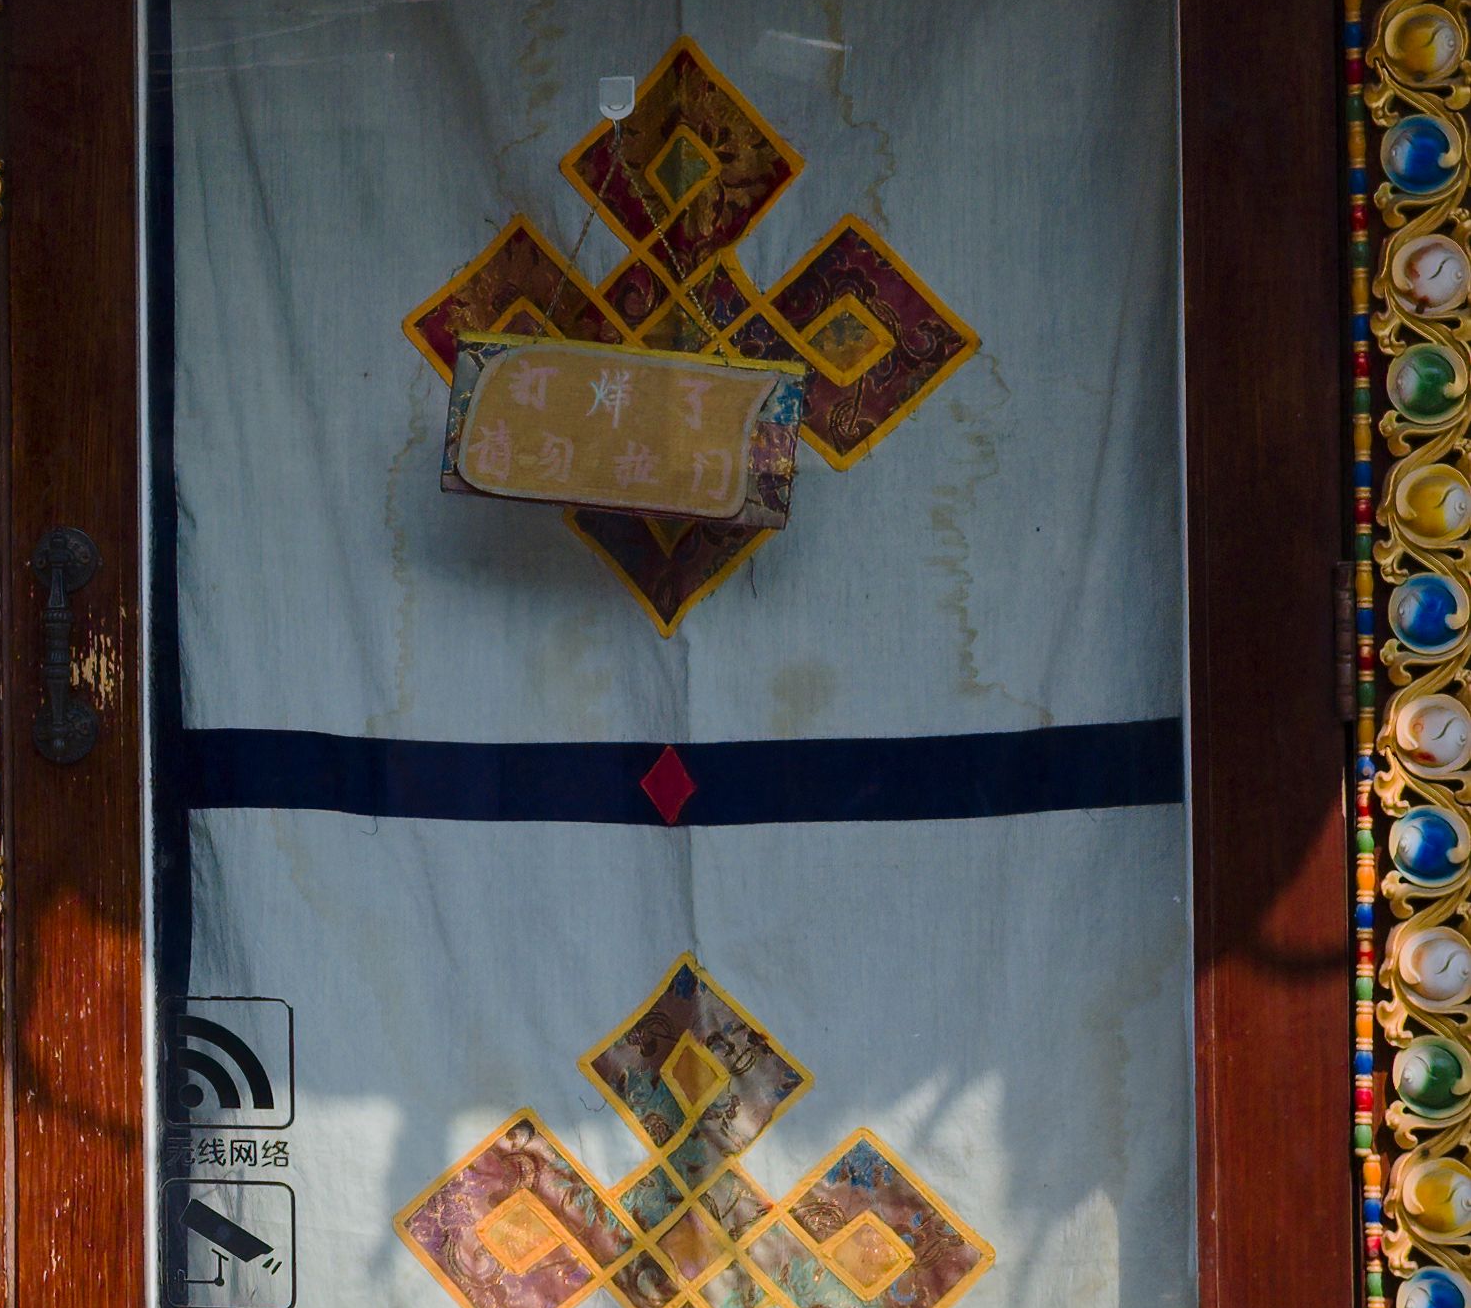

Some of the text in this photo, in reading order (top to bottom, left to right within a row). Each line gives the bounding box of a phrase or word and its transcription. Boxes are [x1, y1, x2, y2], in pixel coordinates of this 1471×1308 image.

[509, 360, 712, 432] 打烊了
[165, 1138, 290, 1168] 无线网络
